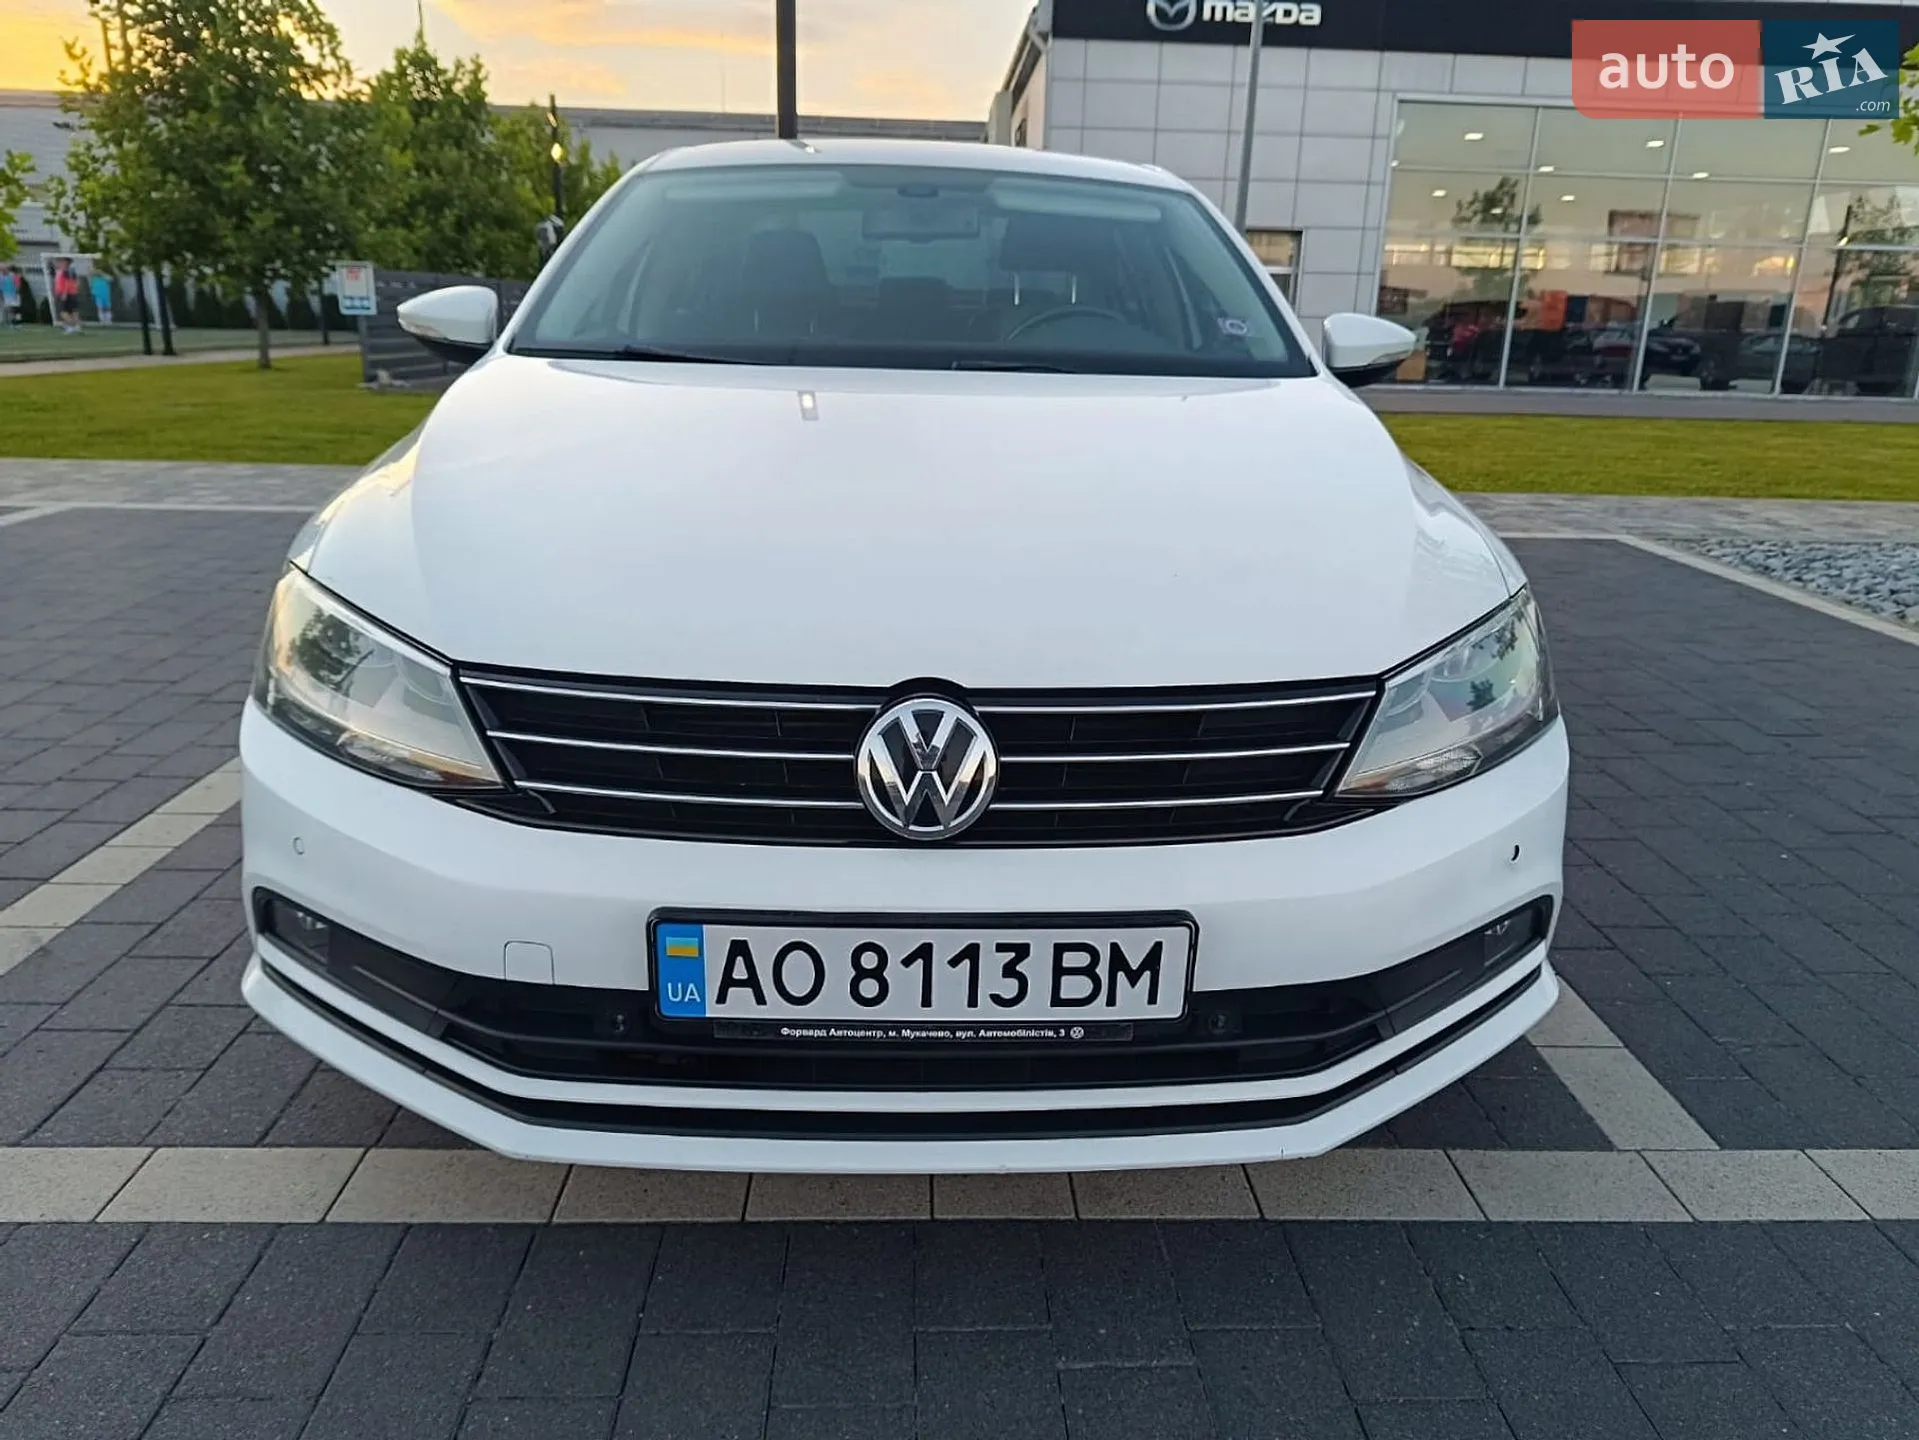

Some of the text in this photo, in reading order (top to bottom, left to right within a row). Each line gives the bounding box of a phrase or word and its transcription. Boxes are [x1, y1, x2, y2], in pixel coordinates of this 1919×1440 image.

[714, 938, 1164, 1009] AO 8113 BM
[667, 982, 701, 1003] UA
[780, 1027, 827, 1038] Форвард
[829, 1027, 886, 1039] Автоцентр,
[1059, 1028, 1066, 1038] 3
